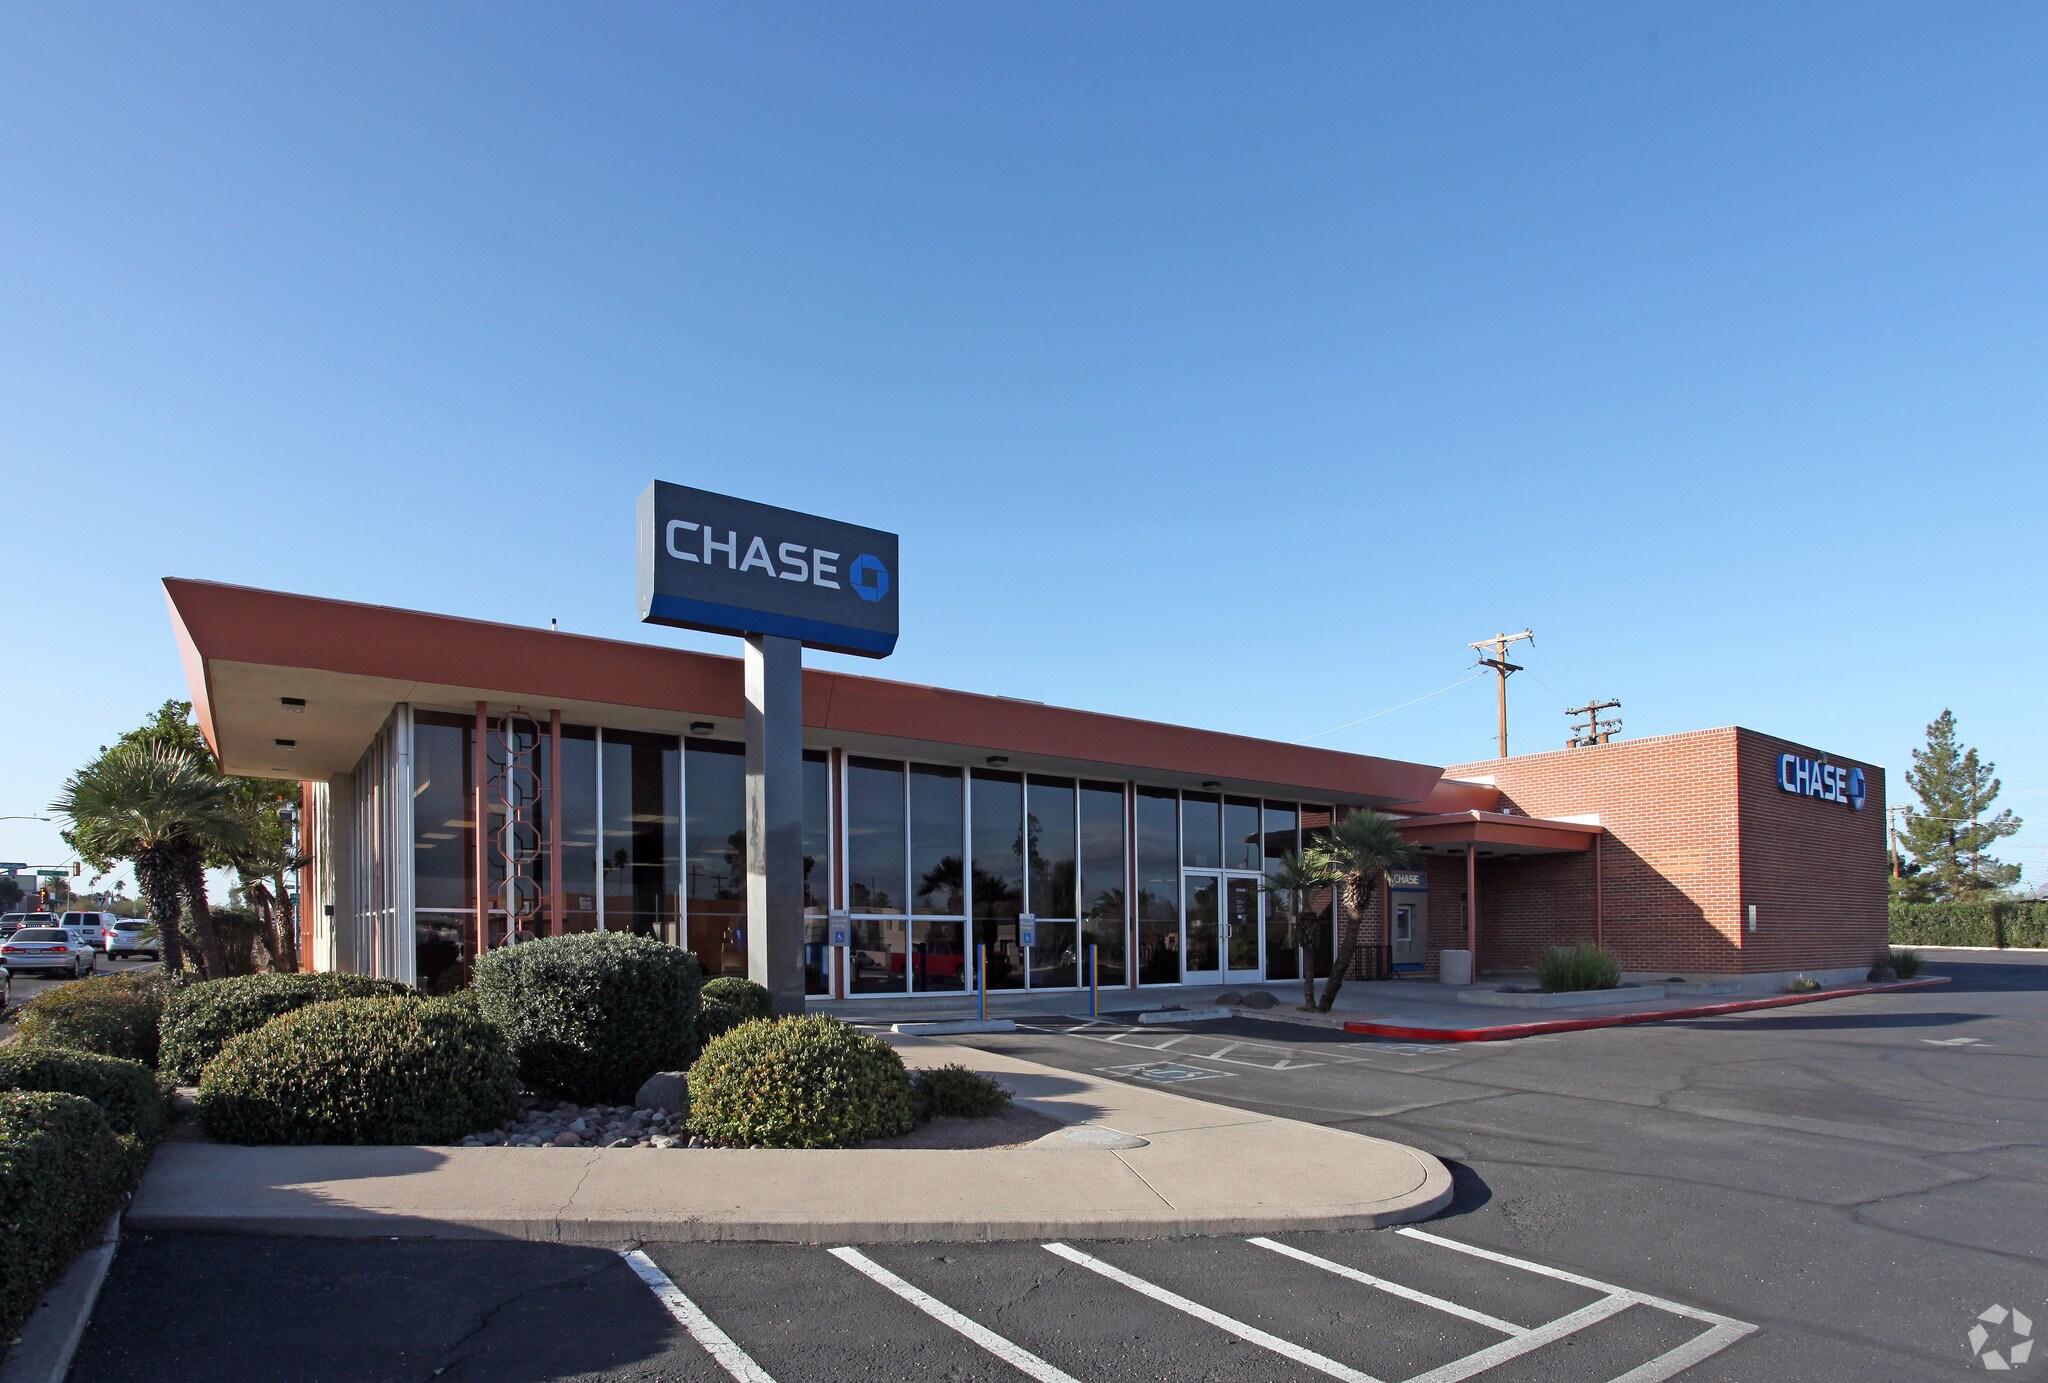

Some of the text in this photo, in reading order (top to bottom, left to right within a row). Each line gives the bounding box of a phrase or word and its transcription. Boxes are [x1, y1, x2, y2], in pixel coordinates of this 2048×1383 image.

[666, 519, 841, 590] CHASE
[1782, 753, 1848, 804] CHASE
[1393, 874, 1419, 885] CHASE
